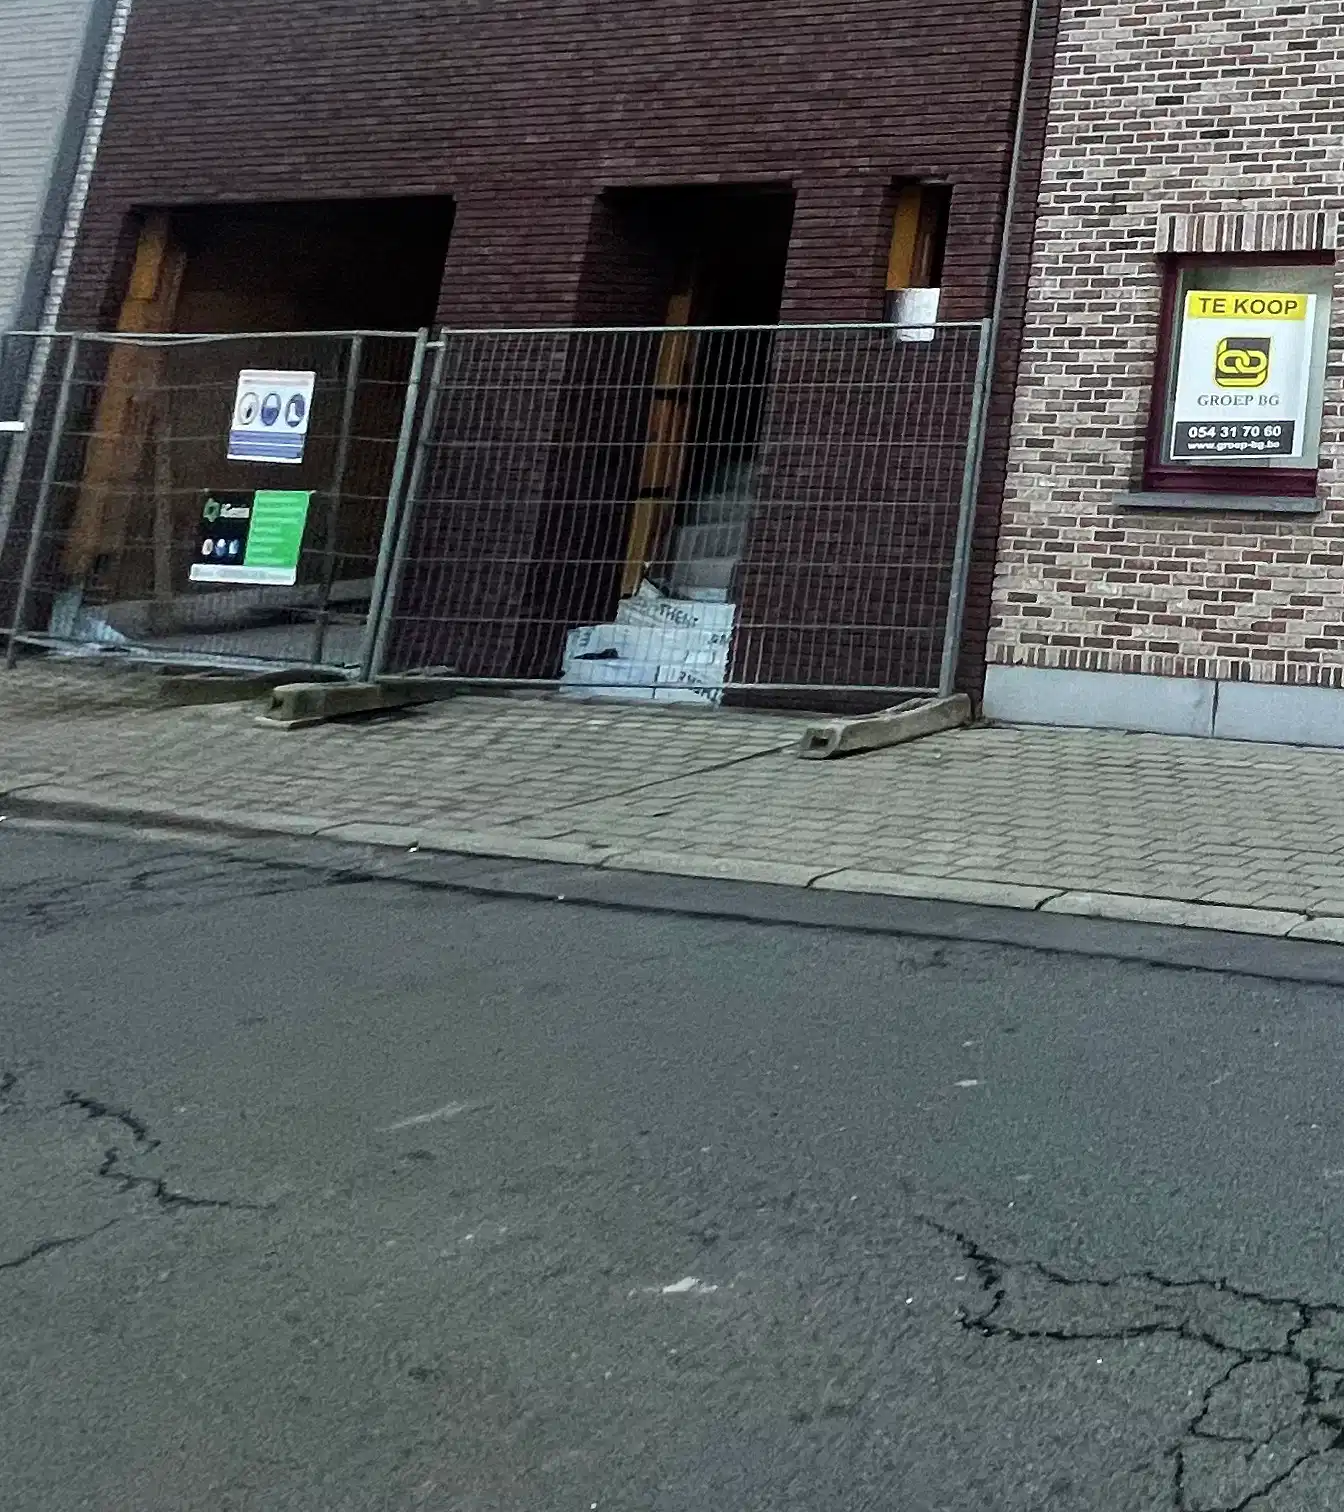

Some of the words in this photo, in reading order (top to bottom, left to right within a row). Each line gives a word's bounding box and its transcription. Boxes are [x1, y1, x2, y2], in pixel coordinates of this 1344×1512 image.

[1199, 297, 1227, 313] TE
[1234, 299, 1298, 315] KOOP
[1197, 395, 1254, 406] GROEP
[1258, 395, 1280, 406] BG
[1188, 426, 1216, 439] 054
[1220, 426, 1237, 438] 31
[1242, 425, 1260, 438] 70
[1263, 425, 1282, 437] 60
[1187, 440, 1280, 451] www.groep-bg.be
